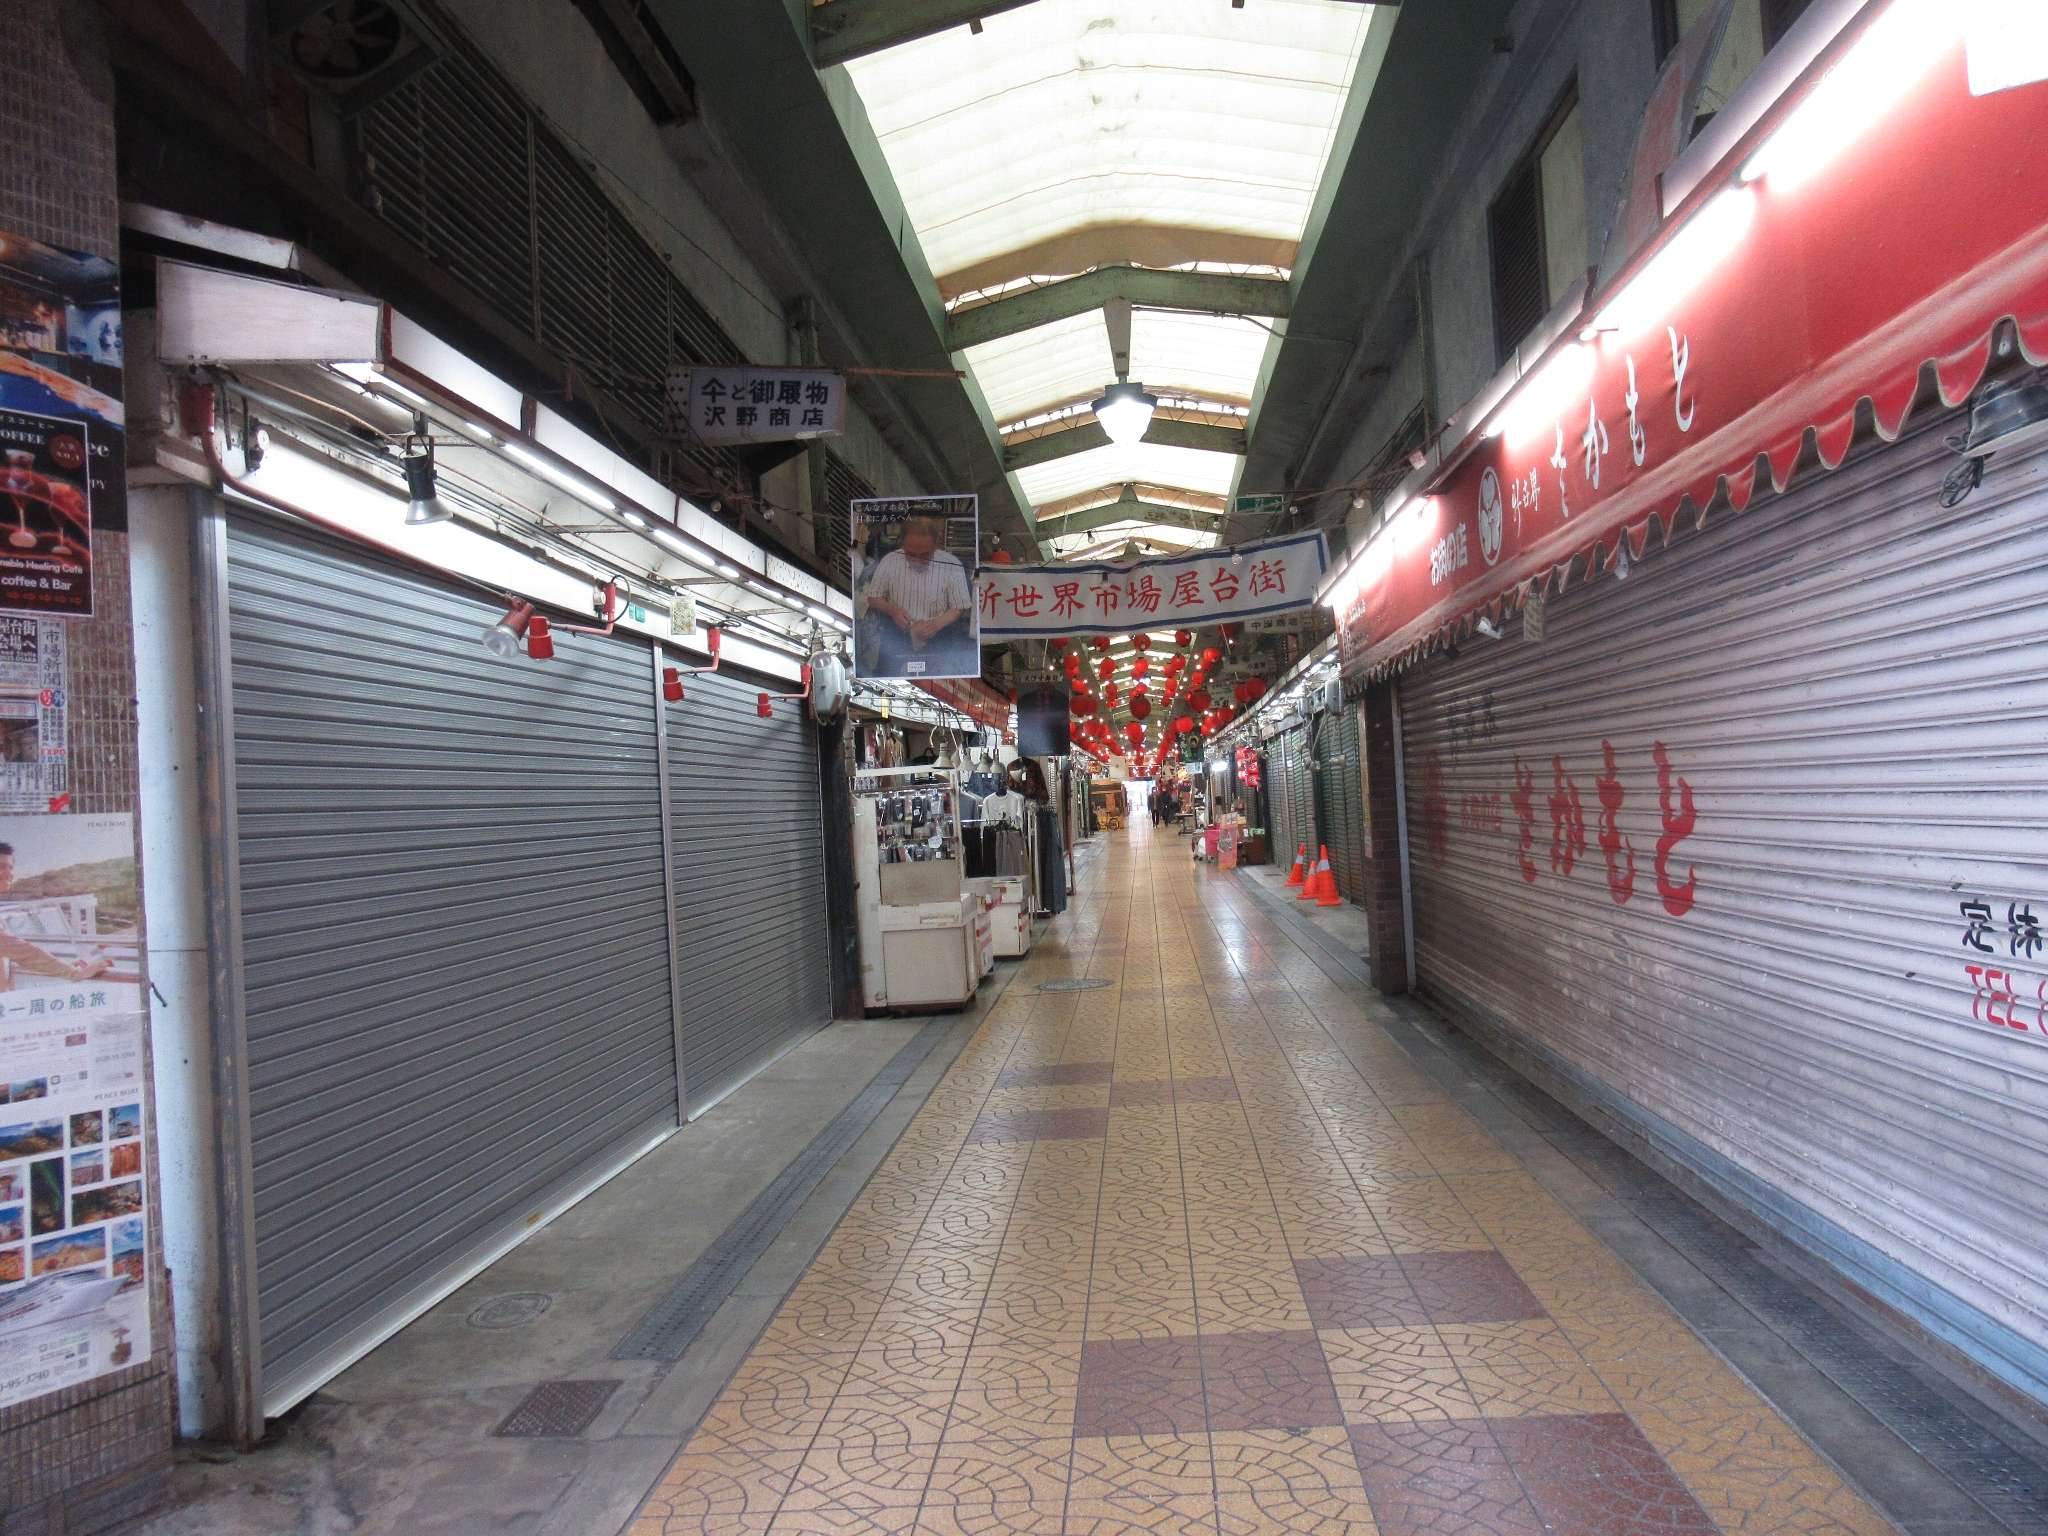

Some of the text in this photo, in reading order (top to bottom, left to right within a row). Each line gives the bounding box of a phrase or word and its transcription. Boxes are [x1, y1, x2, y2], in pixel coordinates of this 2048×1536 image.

[704, 406, 824, 427] 沢野商店
[1, 575, 72, 591] coffee & Bar
[0, 991, 107, 1018] 一周の船旅
[1964, 964, 2029, 1031] TEL
